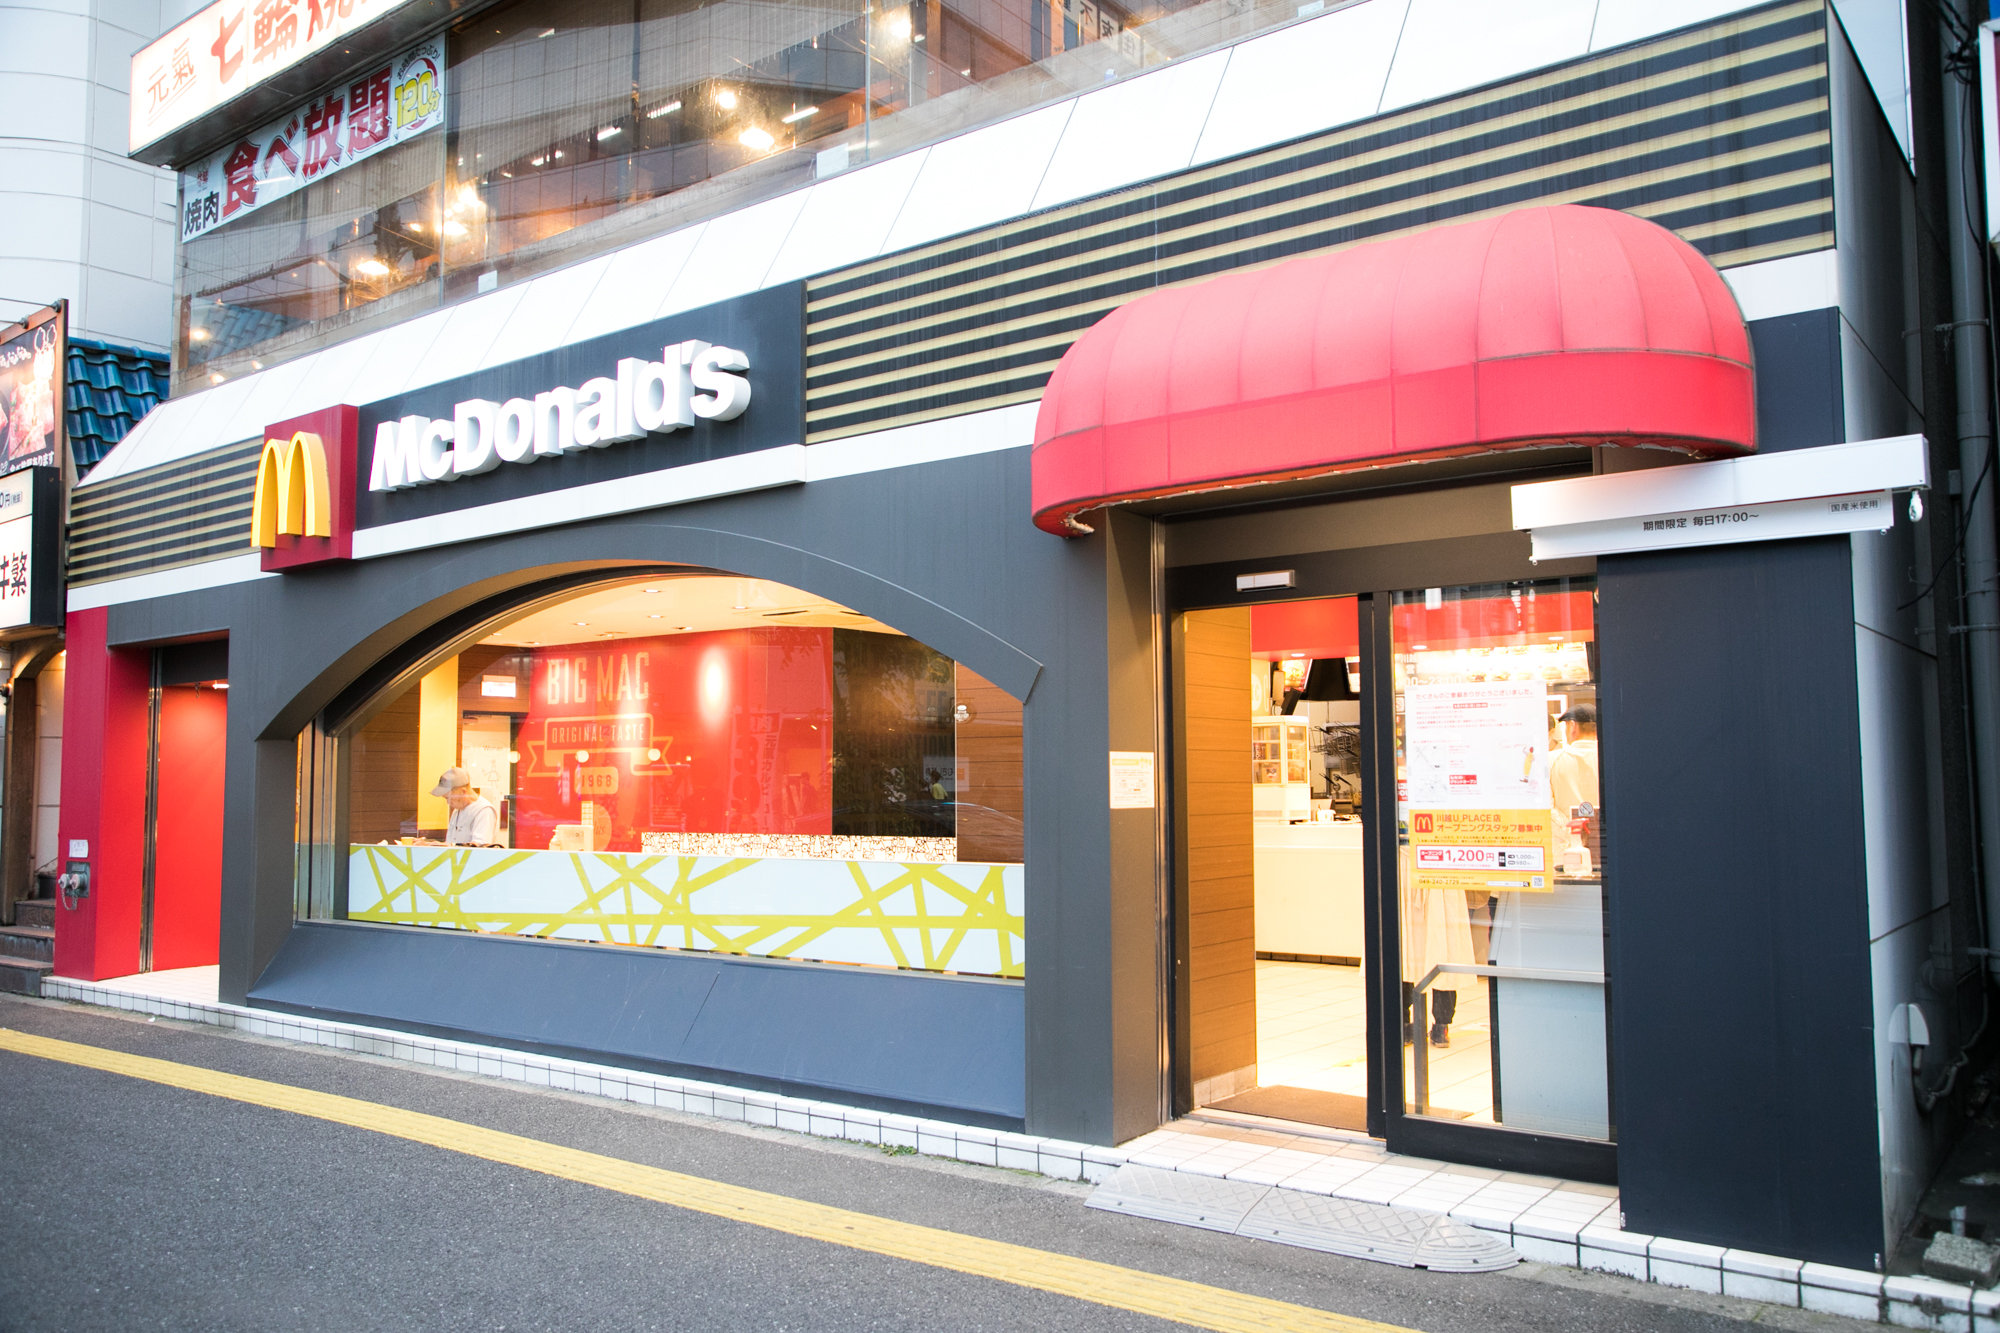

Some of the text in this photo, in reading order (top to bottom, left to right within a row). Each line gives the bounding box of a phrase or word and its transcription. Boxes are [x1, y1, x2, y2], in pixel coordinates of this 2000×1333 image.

[395, 70, 441, 129] 120分
[222, 63, 392, 221] 食べ放題
[184, 190, 220, 236] 焼肉
[369, 339, 751, 493] McDonald's
[1643, 516, 1687, 531] 期間限定
[1830, 499, 1879, 513] 国産米使用
[547, 651, 649, 705] BIG MAC
[552, 723, 645, 743] ORIGINAL TASTE
[581, 773, 612, 788] 1968
[1436, 824, 1543, 833] オープニングスタッフ募集中
